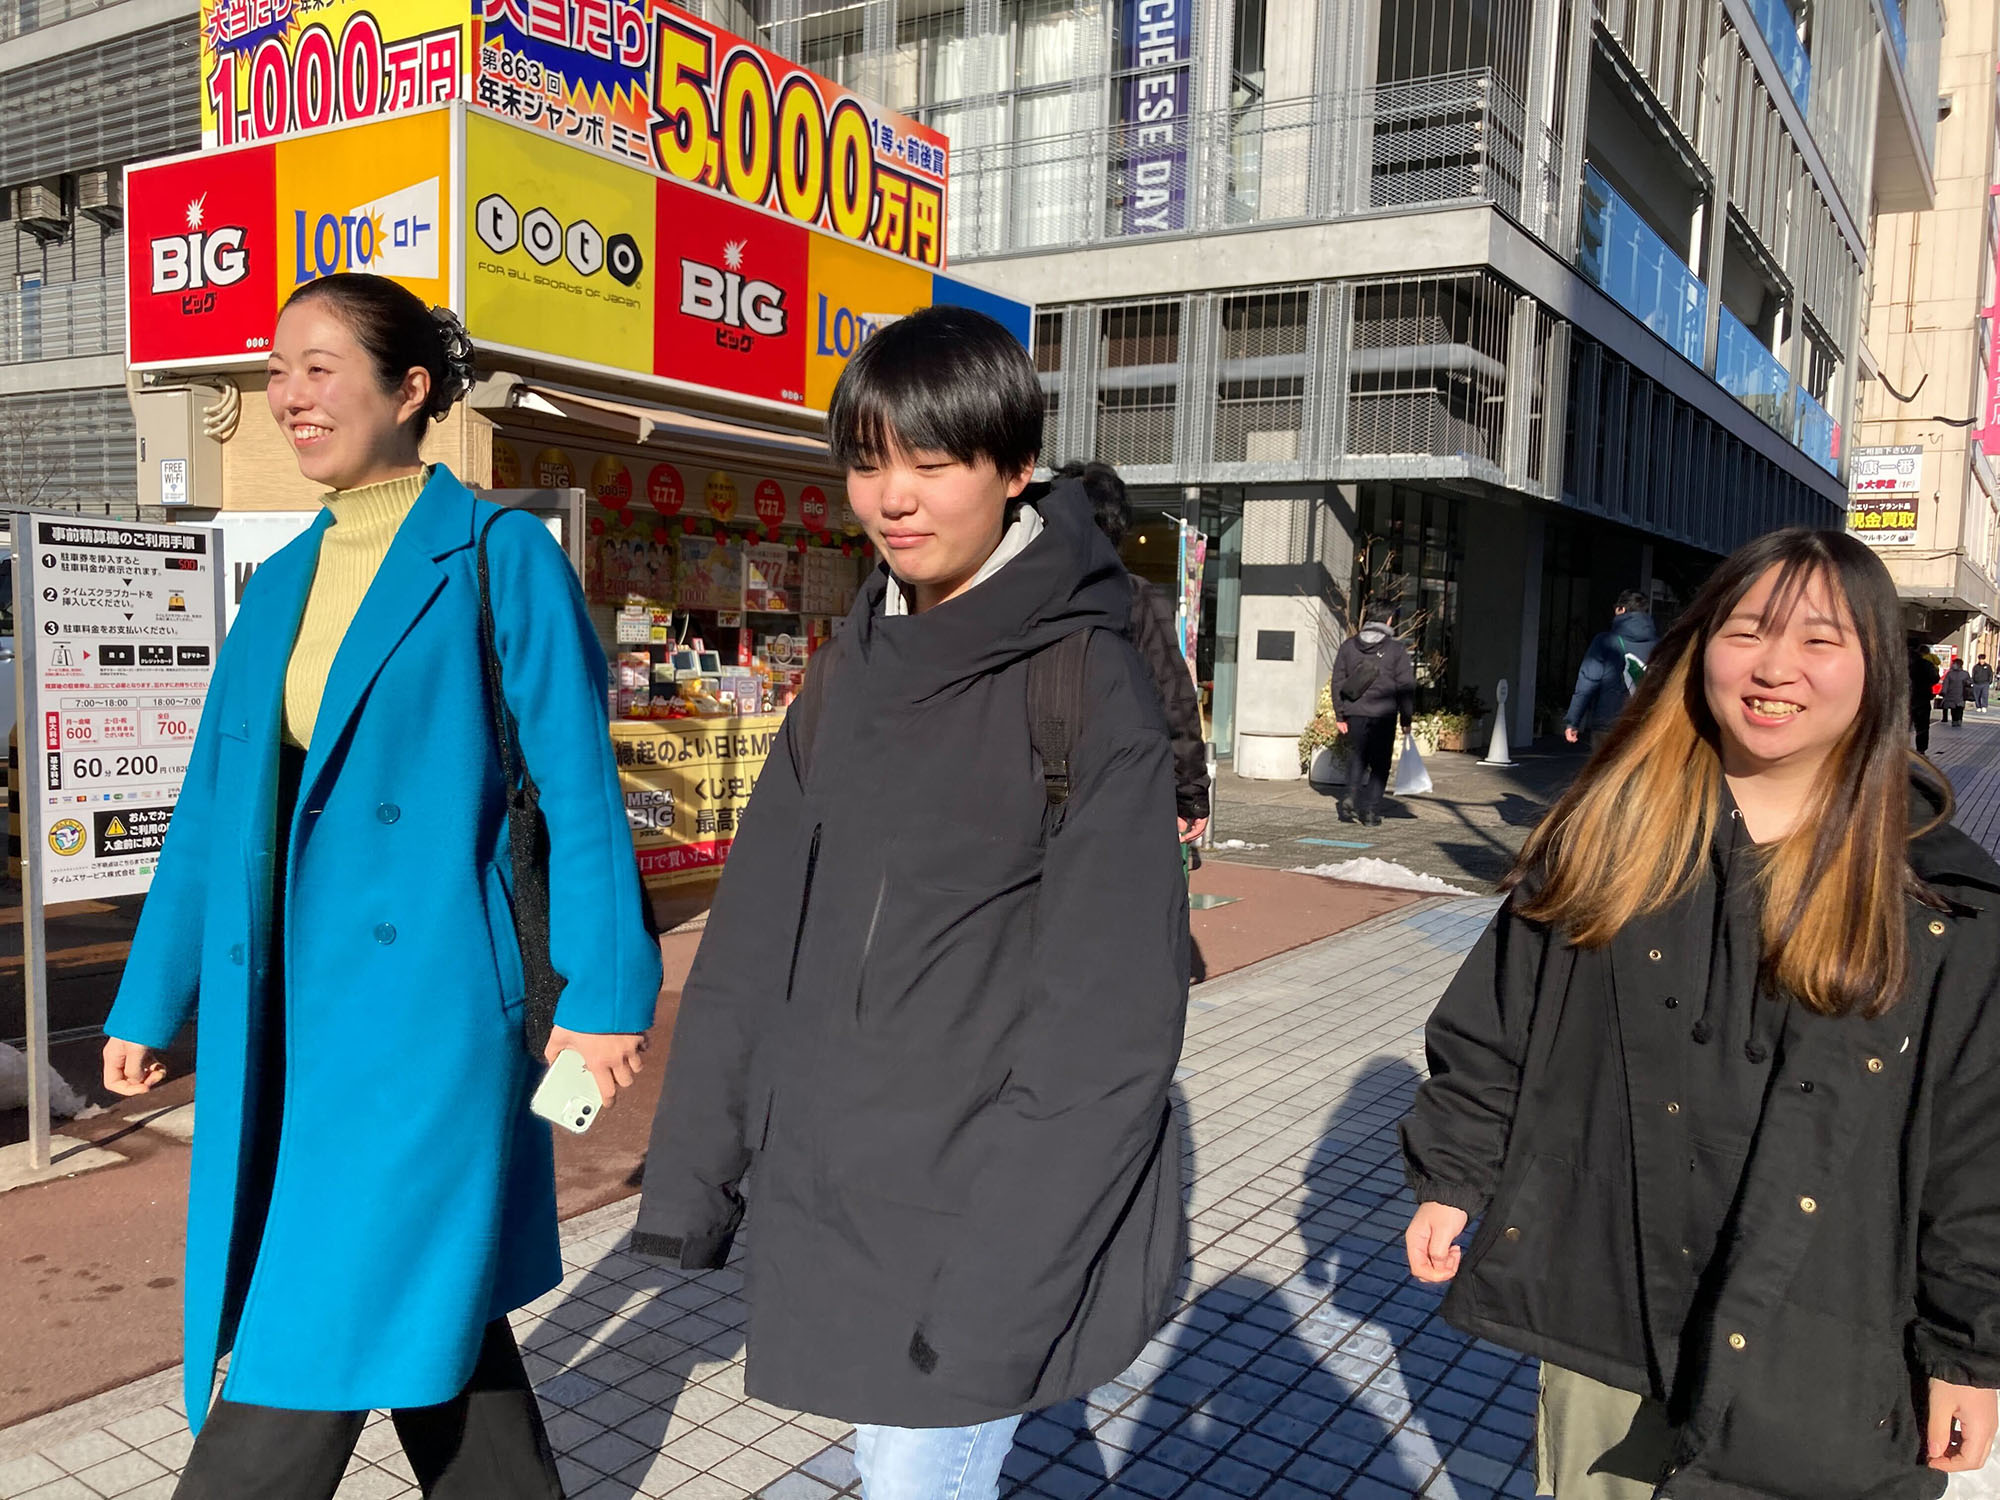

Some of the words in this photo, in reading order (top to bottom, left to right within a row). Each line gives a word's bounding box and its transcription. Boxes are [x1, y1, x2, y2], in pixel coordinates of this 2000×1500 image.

[1138, 0, 1176, 148] CHEESE
[655, 24, 943, 268] 5,000万円
[1134, 161, 1172, 231] DAY
[295, 209, 374, 285] LOTO
[394, 215, 431, 247] ロト
[478, 196, 641, 284] toto
[151, 226, 249, 294] BIG
[478, 262, 506, 276] FOR
[585, 288, 601, 298] OF
[182, 292, 217, 315] ビッグ
[680, 258, 787, 336] BIG
[164, 462, 183, 473] FREE
[539, 462, 570, 475] MEGA
[1856, 458, 1915, 476] 康一番
[164, 474, 183, 484] Wi-Fi
[539, 474, 570, 488] BIG
[803, 501, 824, 515] BIG
[66, 727, 92, 739] 600
[157, 721, 187, 735] 700
[73, 757, 102, 778] 60
[116, 755, 158, 776] 200
[627, 788, 674, 807] MEGA
[627, 805, 675, 830] BIG
[129, 823, 170, 836] ご利用の
